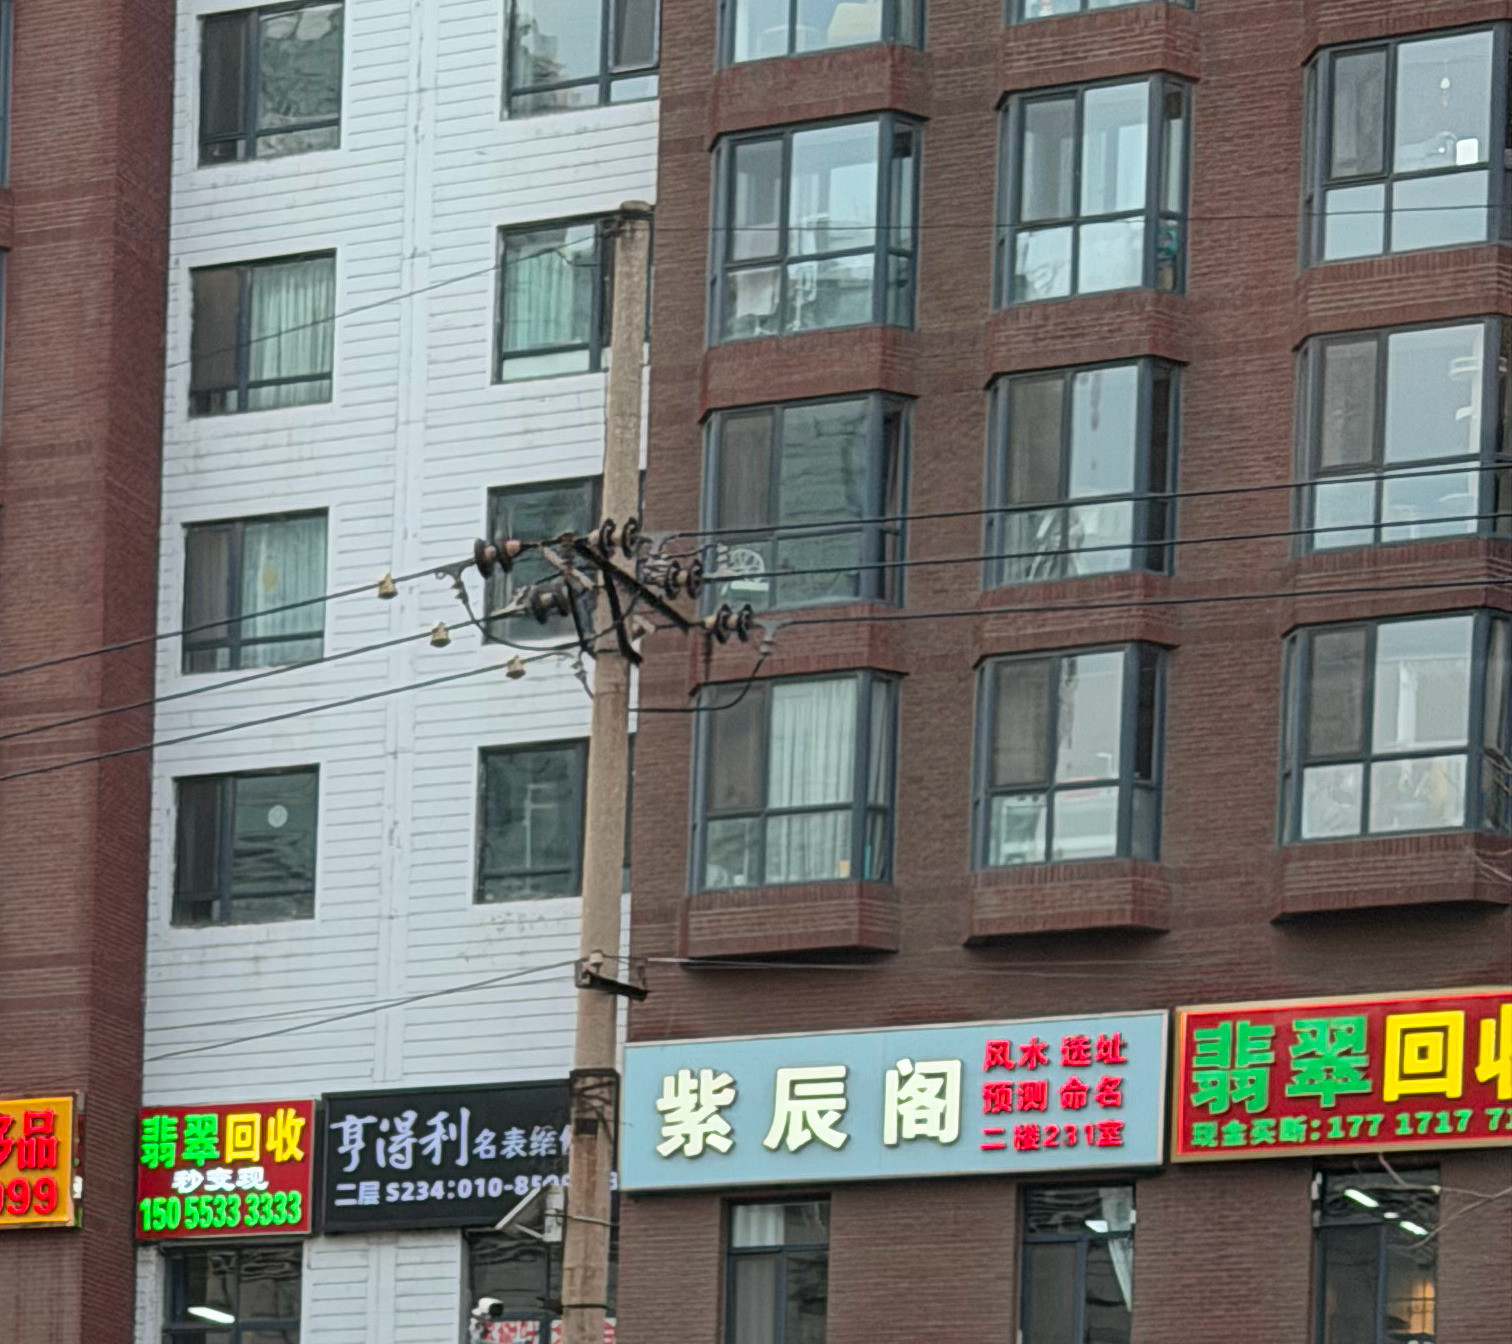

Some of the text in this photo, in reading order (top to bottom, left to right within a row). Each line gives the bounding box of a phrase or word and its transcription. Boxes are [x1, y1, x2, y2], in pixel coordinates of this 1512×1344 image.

[983, 1032, 1128, 1072] 风水 选址
[656, 1057, 963, 1159] 紫辰阁
[982, 1075, 1124, 1115] 预测 命名
[140, 1107, 306, 1169] 翡翠回收
[330, 1106, 471, 1173] 亨得利
[980, 1119, 1125, 1152] 二楼231室
[1395, 1109, 1473, 1136] 1717
[171, 1165, 269, 1194] 秒变现
[334, 1180, 380, 1207] 二层
[139, 1190, 302, 1232] 150 5533 3333
